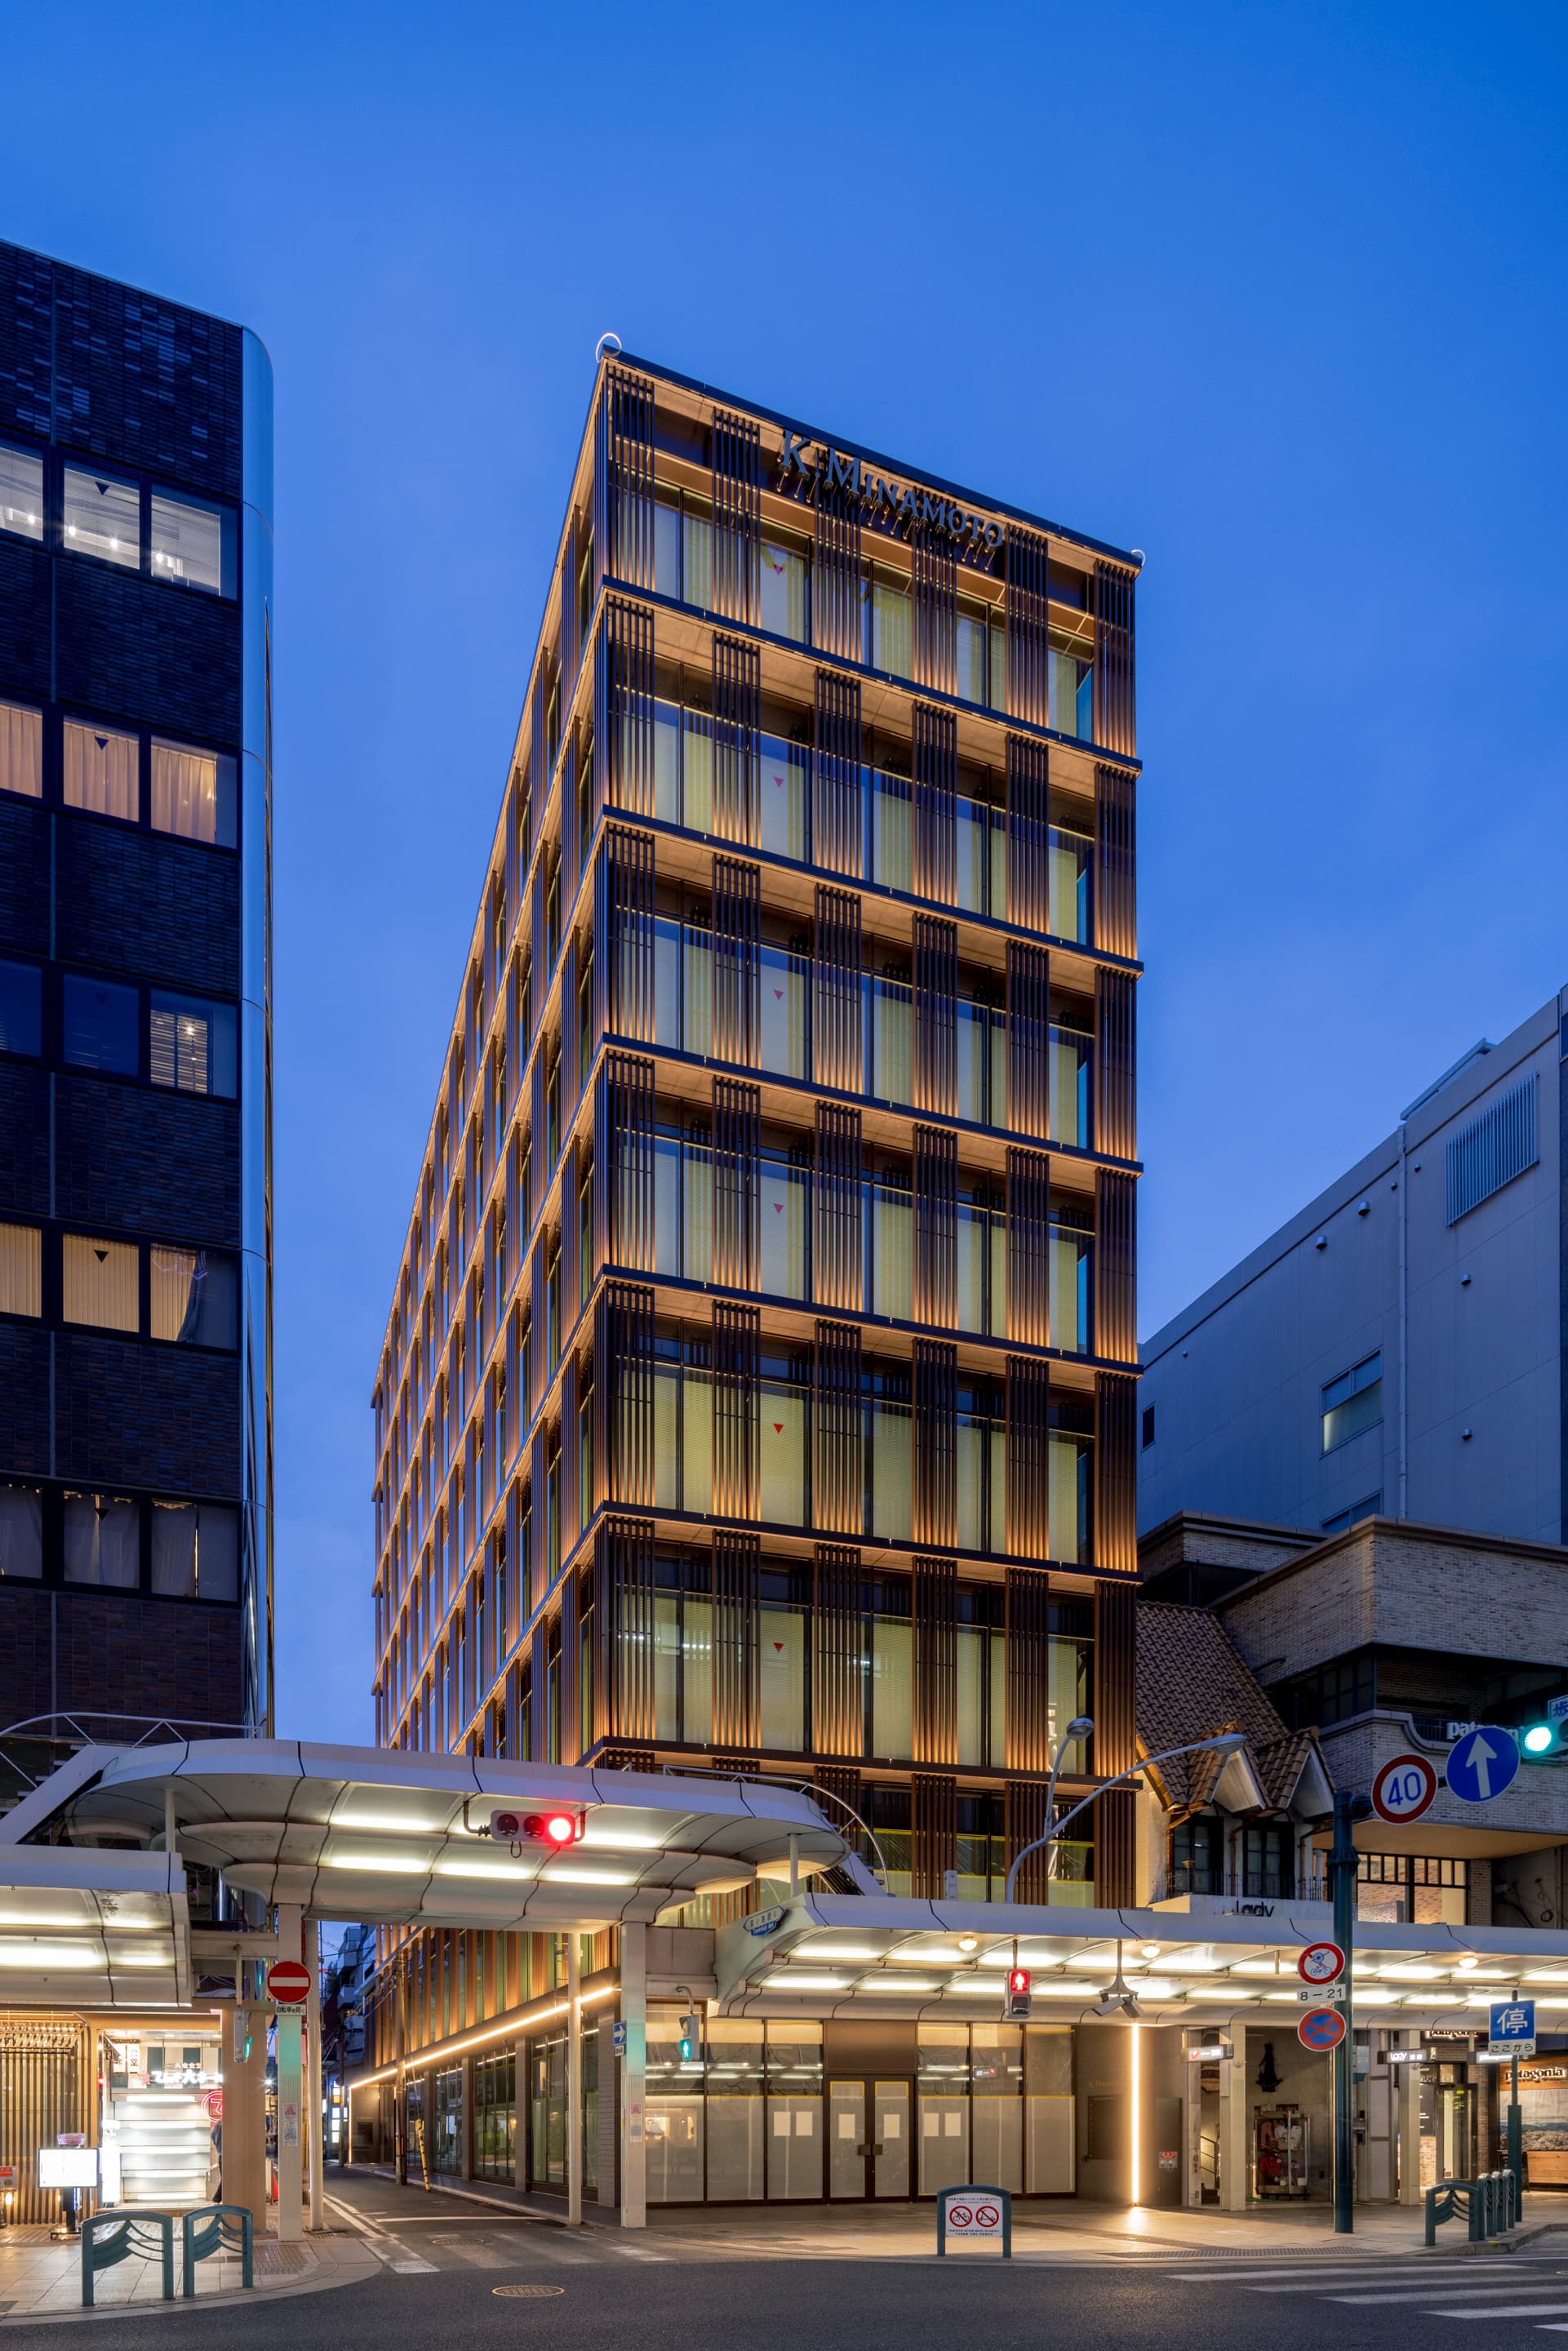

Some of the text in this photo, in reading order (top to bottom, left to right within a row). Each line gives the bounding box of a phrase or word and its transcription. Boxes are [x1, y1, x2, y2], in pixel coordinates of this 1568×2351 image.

[1388, 1772, 1421, 1806] 40
[1496, 2008, 1528, 2034] 停
[1491, 2043, 1533, 2053] ここから
[1505, 2067, 1564, 2079] ptagonia
